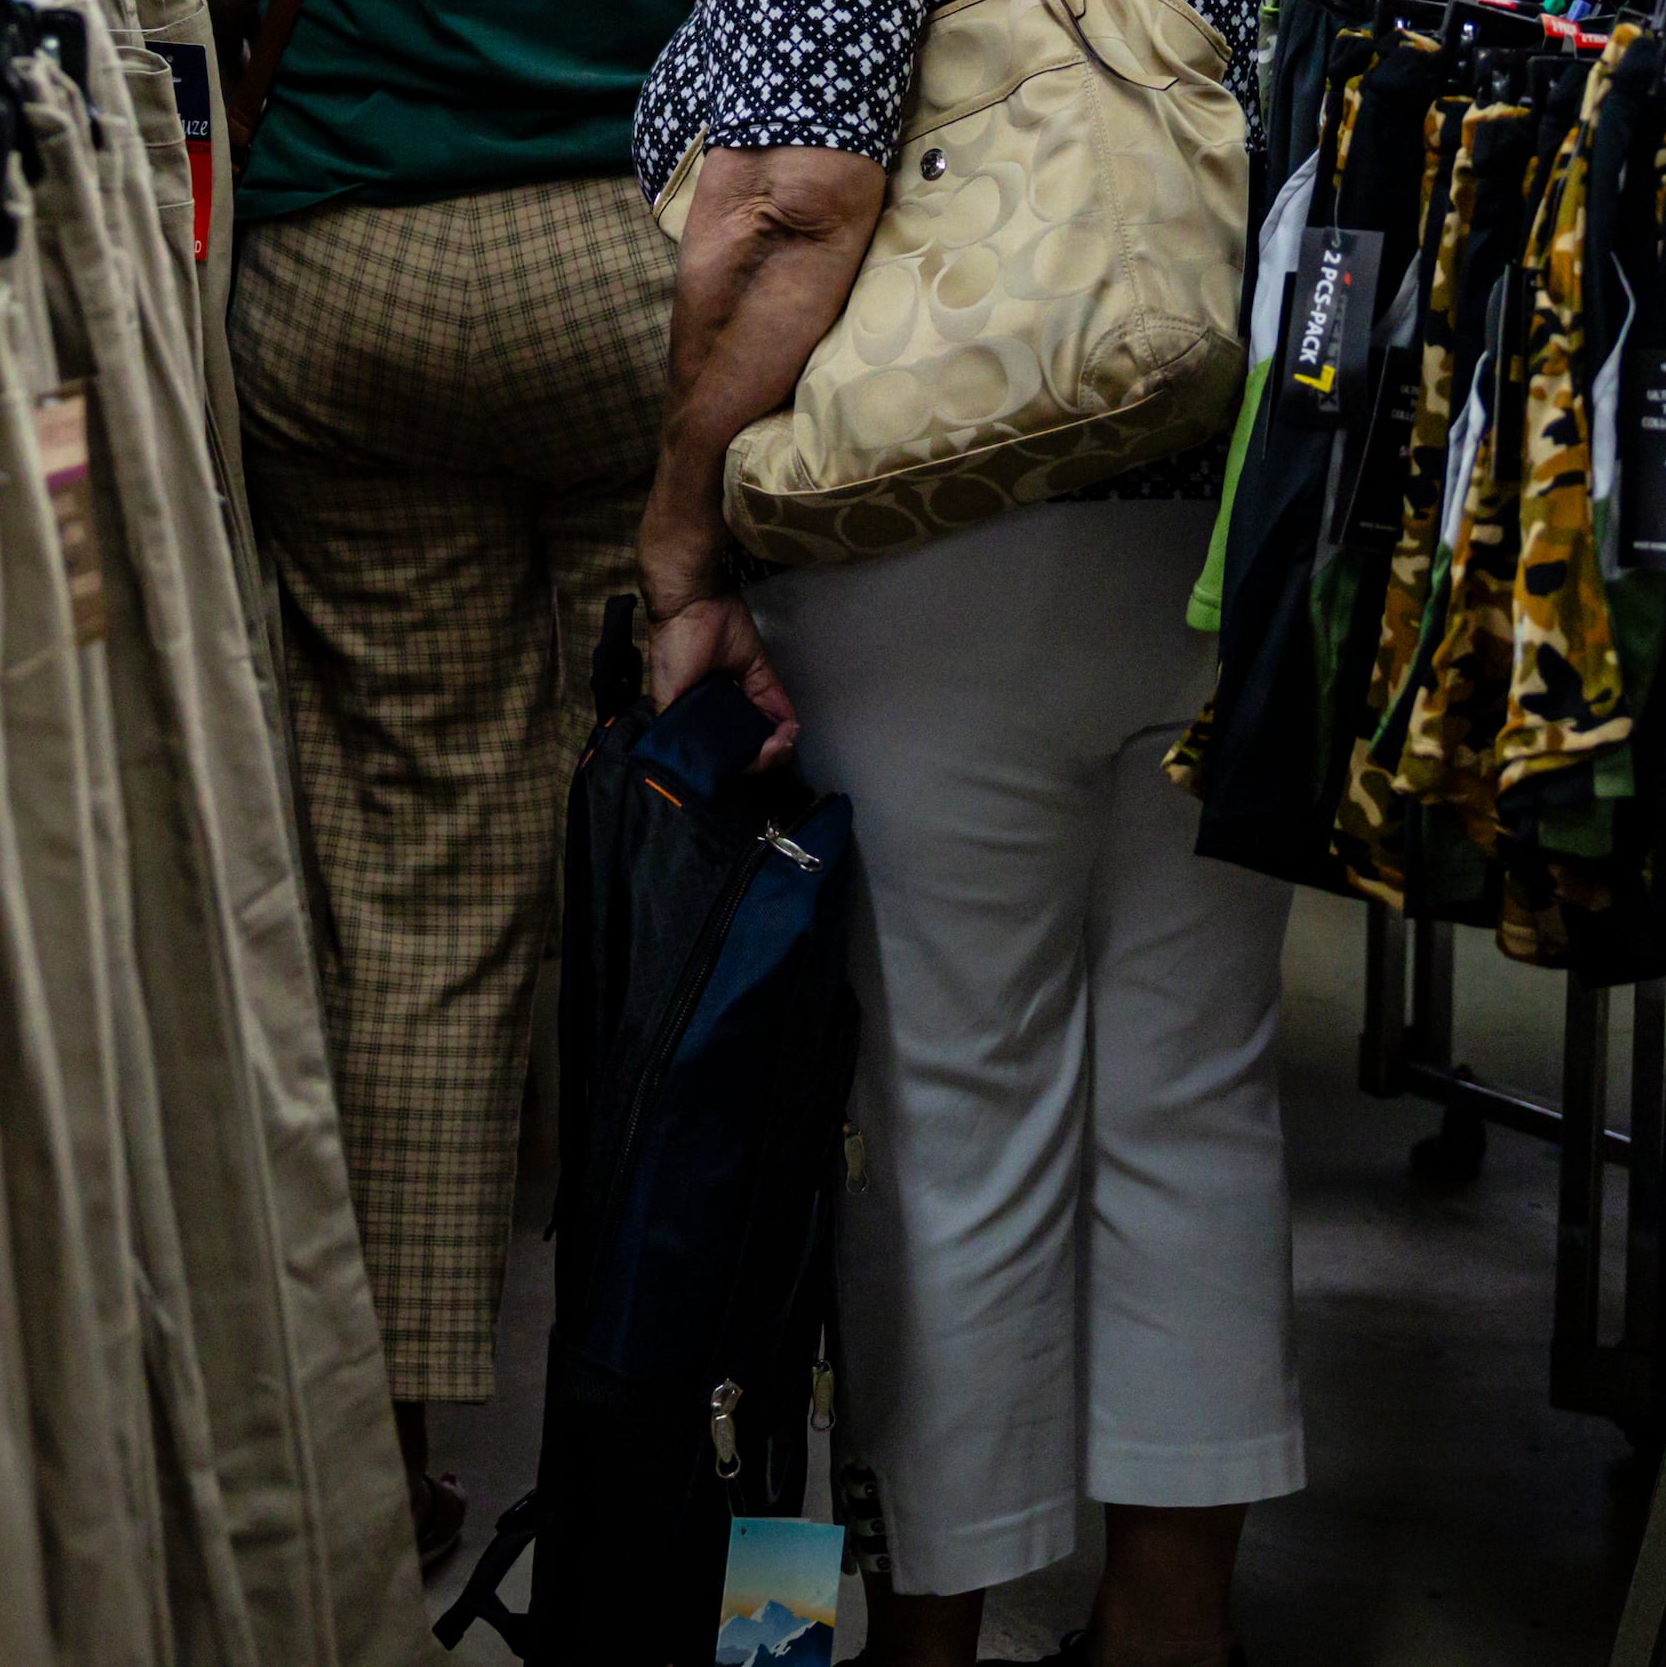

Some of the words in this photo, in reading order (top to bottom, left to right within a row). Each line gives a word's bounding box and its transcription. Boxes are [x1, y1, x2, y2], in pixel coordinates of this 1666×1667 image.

[177, 113, 208, 136] uze
[1323, 249, 1342, 265] 2
[1299, 266, 1339, 365] PCS-PACK
